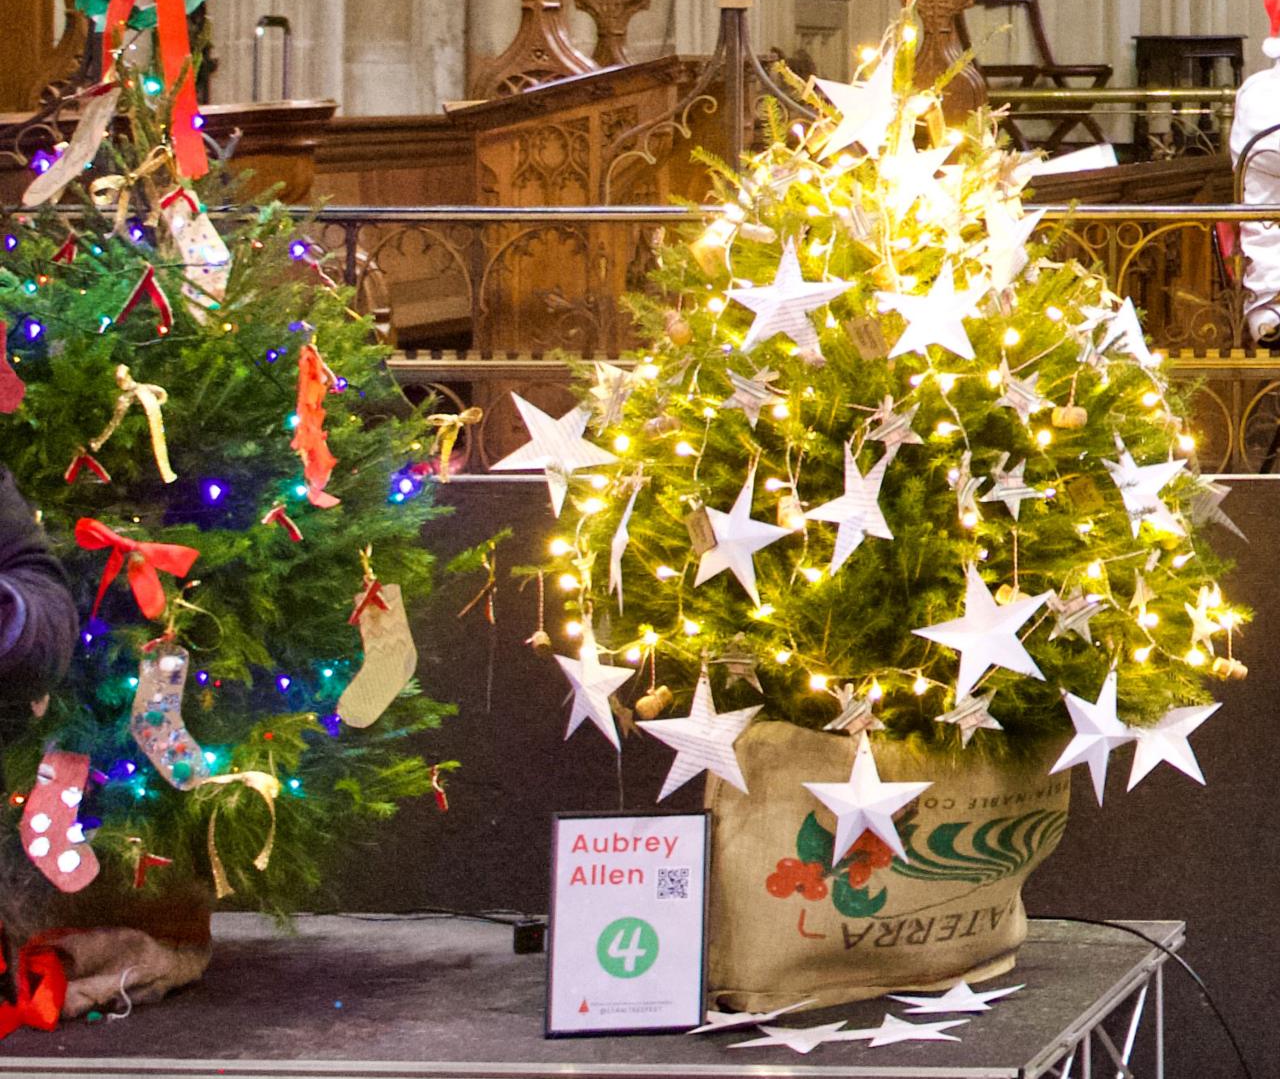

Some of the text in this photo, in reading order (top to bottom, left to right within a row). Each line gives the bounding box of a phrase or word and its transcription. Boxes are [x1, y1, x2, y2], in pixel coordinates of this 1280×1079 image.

[571, 832, 679, 858] Aubrey
[570, 864, 645, 887] Allen
[841, 902, 1014, 950] ATERRA
[607, 925, 648, 972] 4
